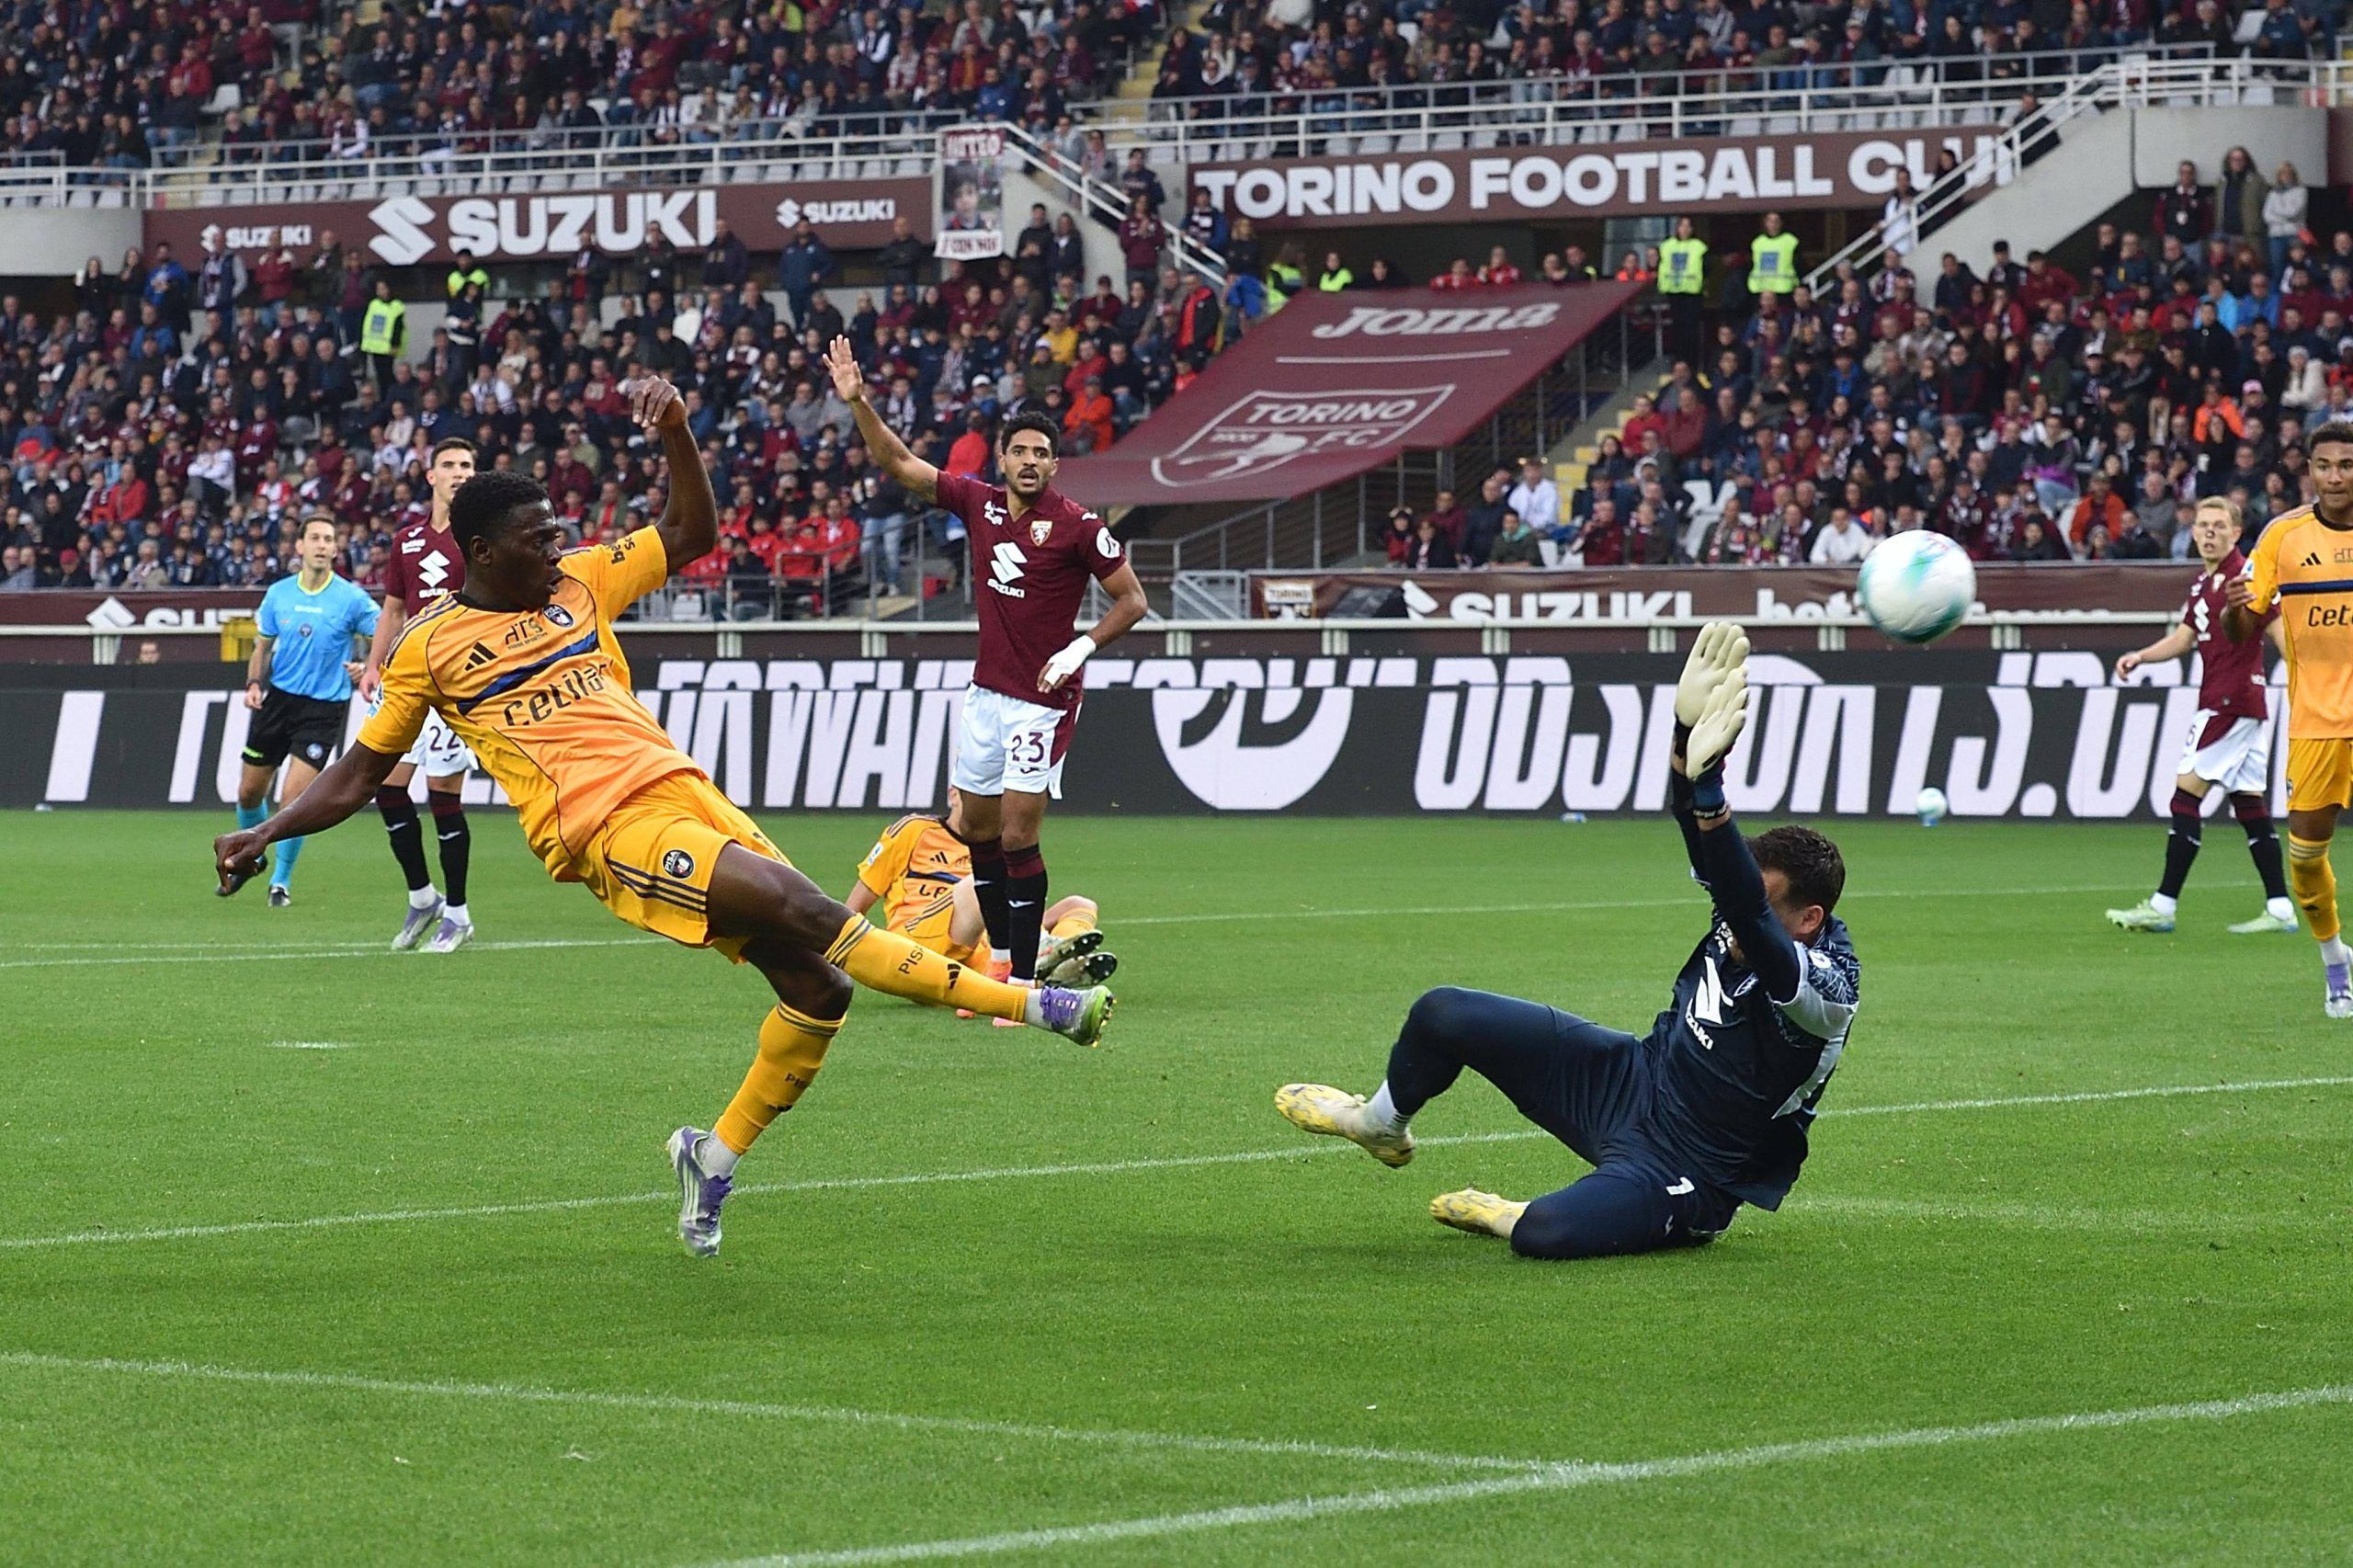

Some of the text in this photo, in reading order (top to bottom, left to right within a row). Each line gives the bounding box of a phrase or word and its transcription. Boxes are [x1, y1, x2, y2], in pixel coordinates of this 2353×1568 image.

[1196, 160, 1454, 219] TORINO
[1471, 144, 1833, 208] FOOTBALL
[448, 189, 717, 256] SUZUKI
[803, 198, 895, 223] SUZUKI
[1246, 399, 1417, 424] TORINO
[1011, 732, 1046, 763] 23
